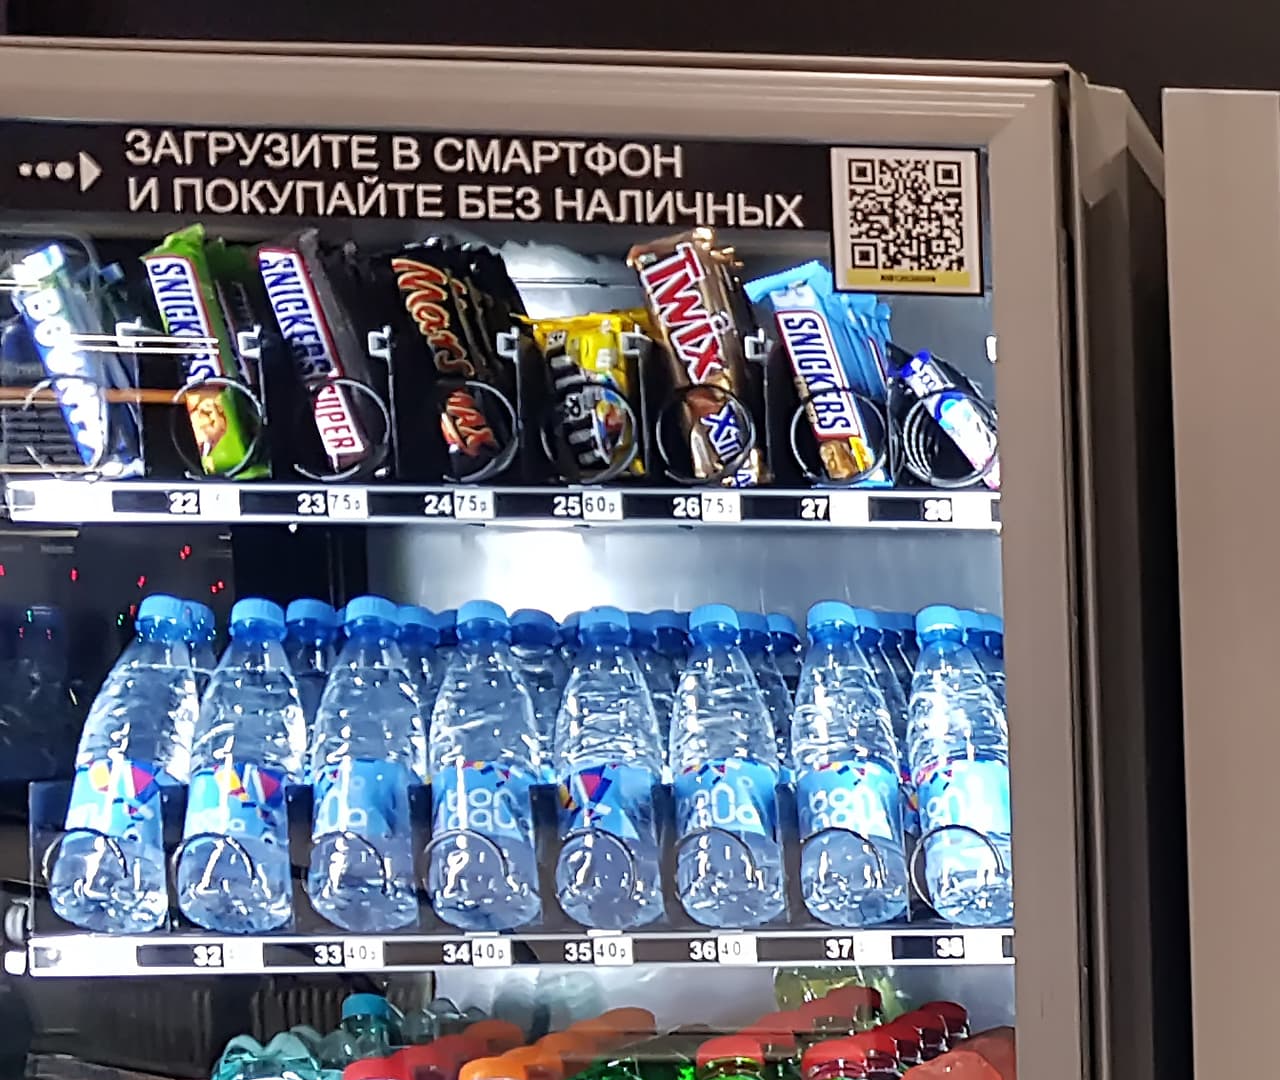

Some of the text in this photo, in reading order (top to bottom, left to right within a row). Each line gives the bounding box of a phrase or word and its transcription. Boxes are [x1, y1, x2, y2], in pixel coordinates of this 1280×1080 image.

[124, 128, 684, 179] ЗАГРУЗИТЕ В СМАРТФОН
[127, 175, 805, 229] И ПОКУПАЙТЕ БЕЗ НАЛИЧНЫХ
[638, 243, 724, 384] TWIX
[784, 315, 850, 440] SNICKERS
[169, 492, 198, 514] 22
[297, 493, 327, 514] 23
[423, 495, 453, 516] 24
[553, 496, 581, 517] 25
[442, 943, 471, 963] 34
[564, 942, 592, 962] 35
